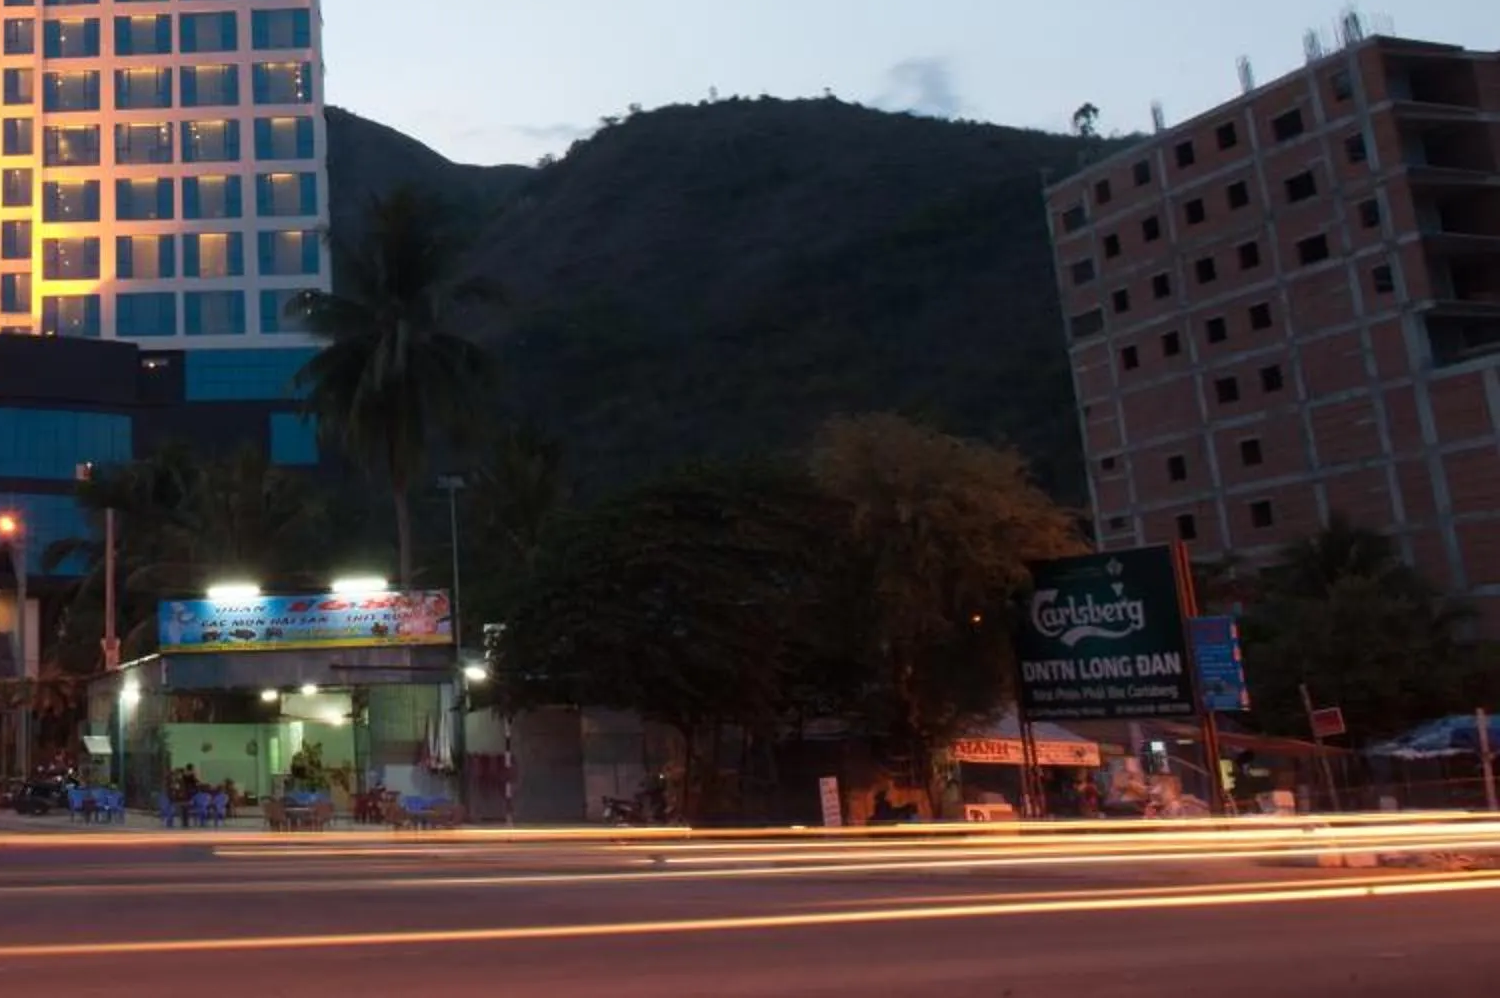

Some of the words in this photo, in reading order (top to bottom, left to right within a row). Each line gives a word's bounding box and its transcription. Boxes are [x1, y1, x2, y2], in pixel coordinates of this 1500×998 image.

[1031, 588, 1146, 646] Carlsberg
[1021, 659, 1076, 683] DNTN
[1078, 655, 1132, 681] LONG
